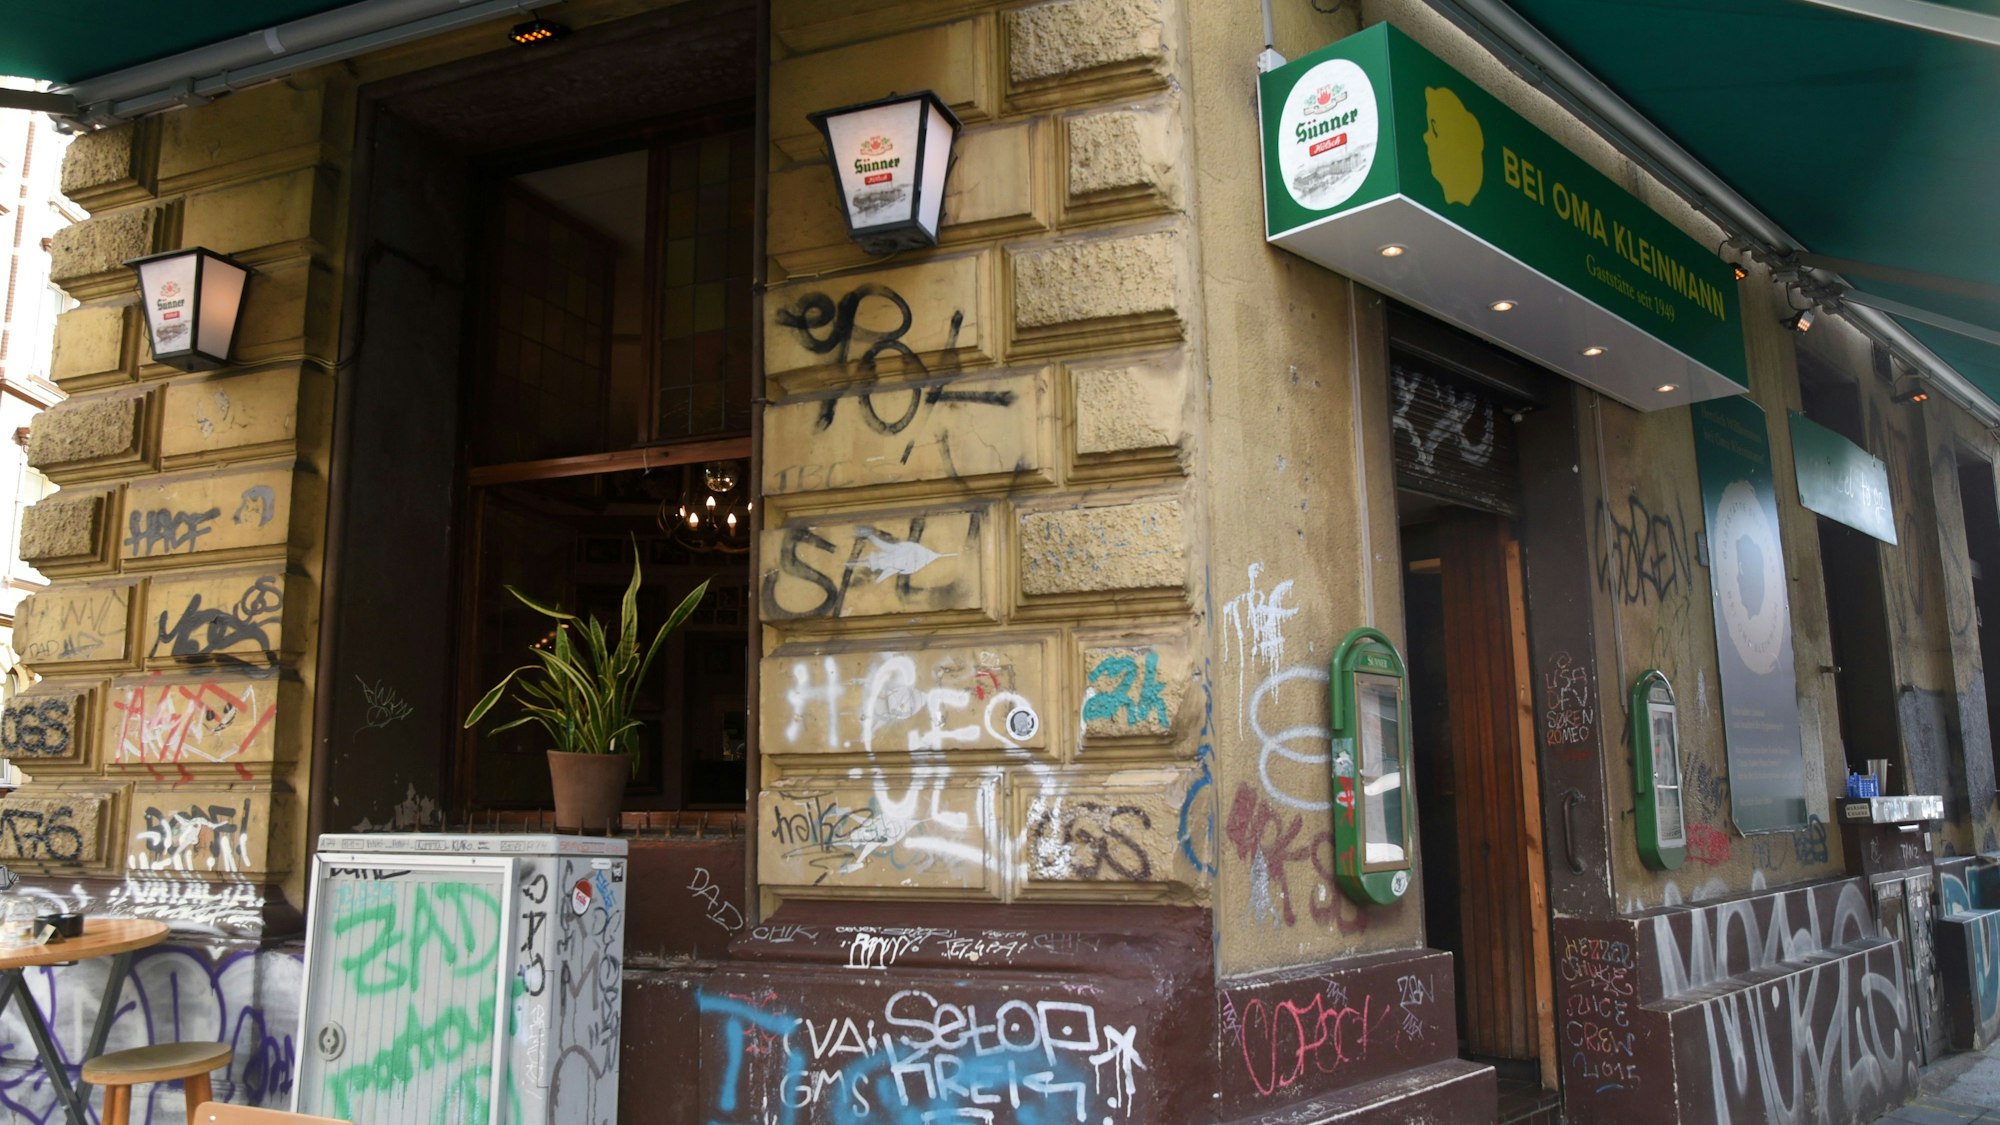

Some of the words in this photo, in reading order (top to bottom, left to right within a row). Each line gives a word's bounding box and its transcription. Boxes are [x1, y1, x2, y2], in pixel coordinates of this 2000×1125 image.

[1295, 107, 1358, 144] Sünner
[854, 156, 901, 174] Sünner
[1503, 146, 1545, 206] BEI
[1552, 182, 1609, 247] OMA
[1613, 221, 1725, 320] KLEINMANN
[1586, 254, 1635, 299] Gaststätte
[1637, 290, 1653, 306] seit
[1655, 296, 1675, 322] 1949
[1566, 1020, 1635, 1057] CREW
